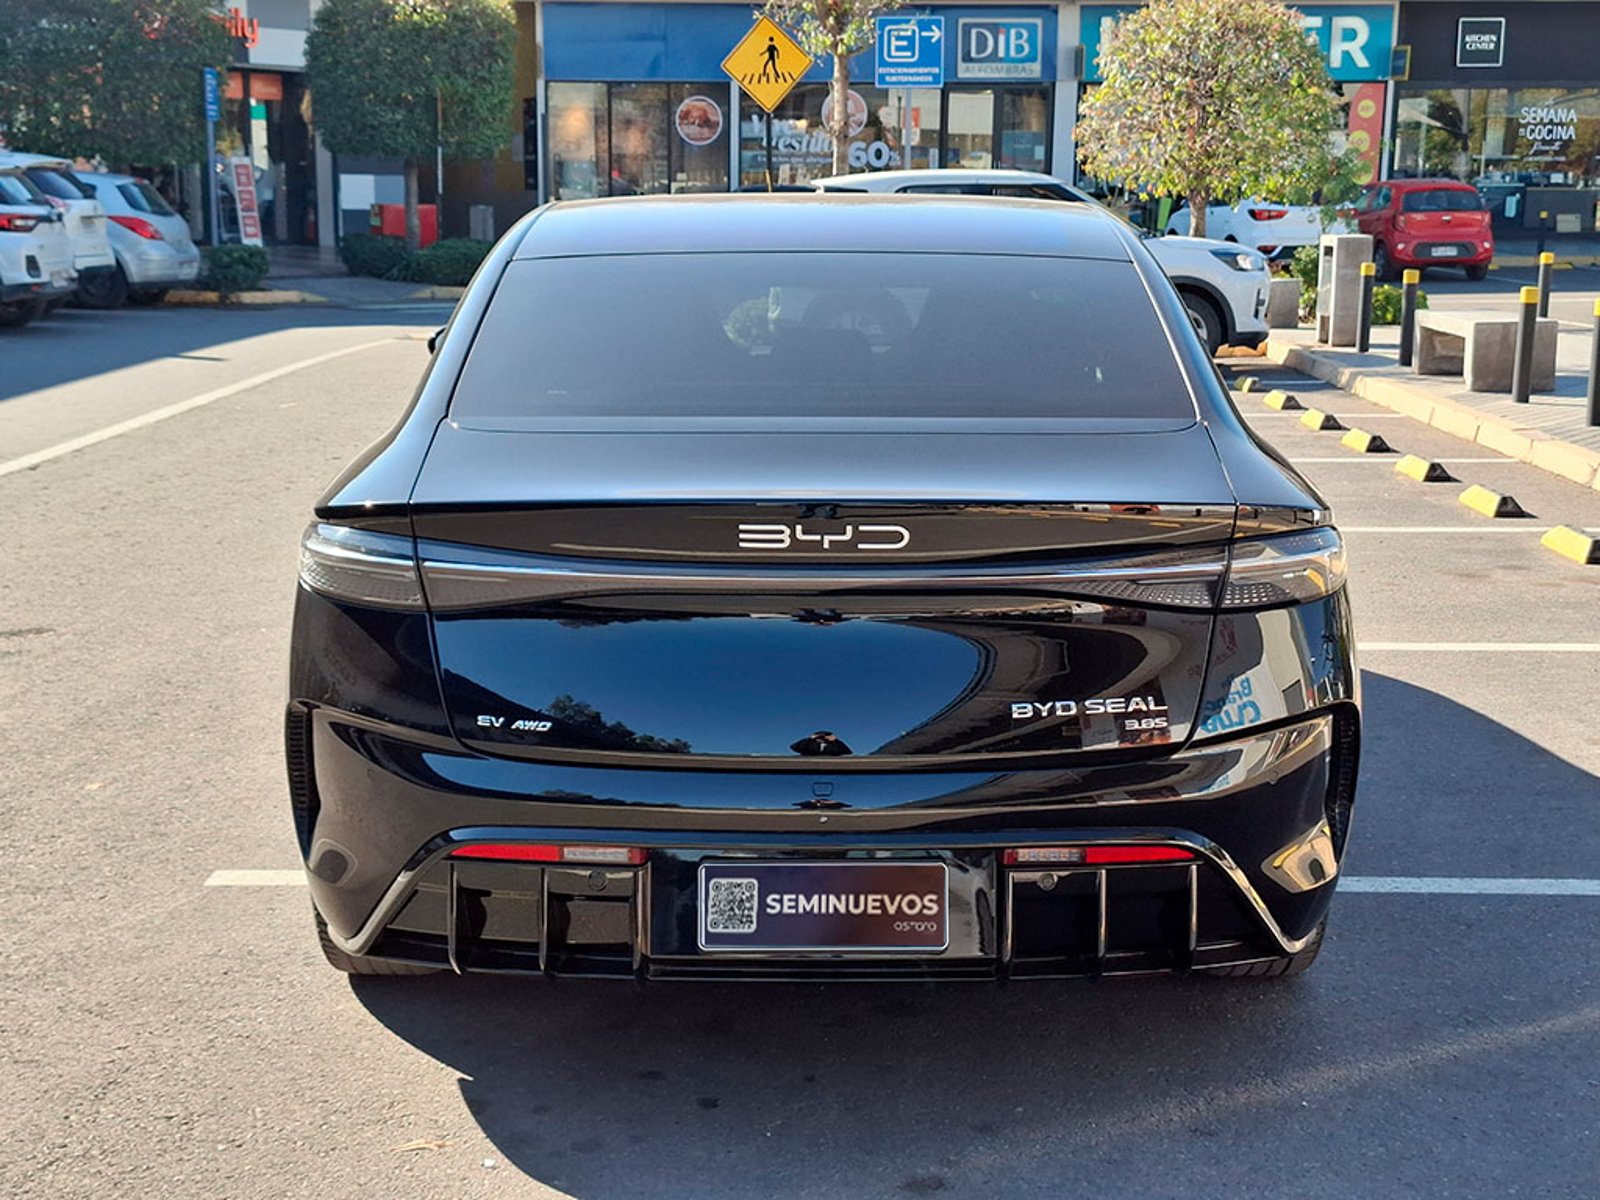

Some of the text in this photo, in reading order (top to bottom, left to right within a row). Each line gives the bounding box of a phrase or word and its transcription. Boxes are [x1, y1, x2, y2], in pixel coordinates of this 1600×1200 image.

[1465, 42, 1496, 50] CENTER
[964, 64, 1035, 75] ALFOMBRAS
[1519, 106, 1577, 124] SEMANA
[1526, 125, 1576, 140] COCINA
[738, 524, 911, 550] BYD
[1011, 696, 1168, 719] BYD SEAL
[477, 715, 552, 731] EV AWD
[765, 893, 939, 915] SEMINUEVOS
